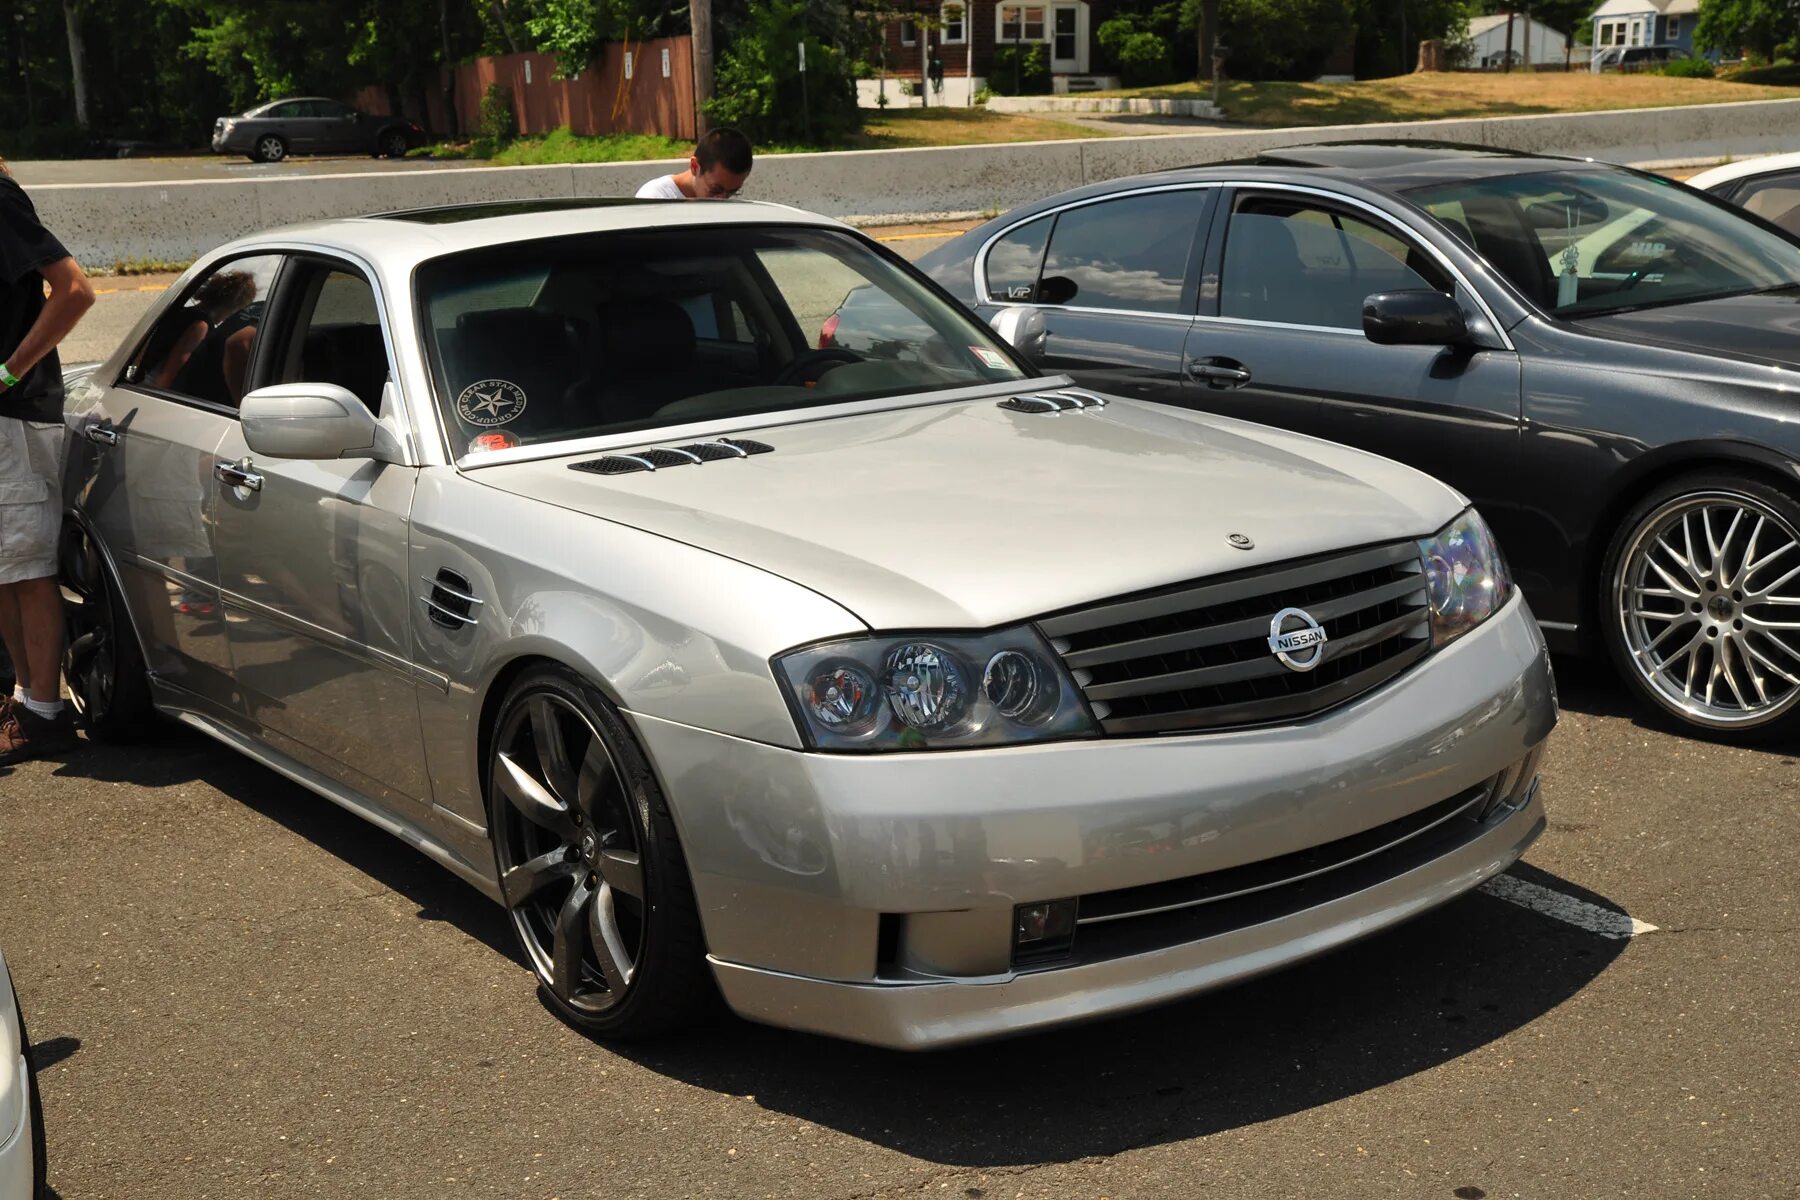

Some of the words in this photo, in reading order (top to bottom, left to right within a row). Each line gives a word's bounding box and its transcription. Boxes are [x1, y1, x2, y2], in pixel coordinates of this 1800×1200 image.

[1008, 286, 1031, 298] VIP
[461, 382, 487, 403] CLEAR
[489, 381, 514, 391] STAR
[511, 390, 523, 413] MEDIA
[1277, 630, 1323, 649] NISSAN
